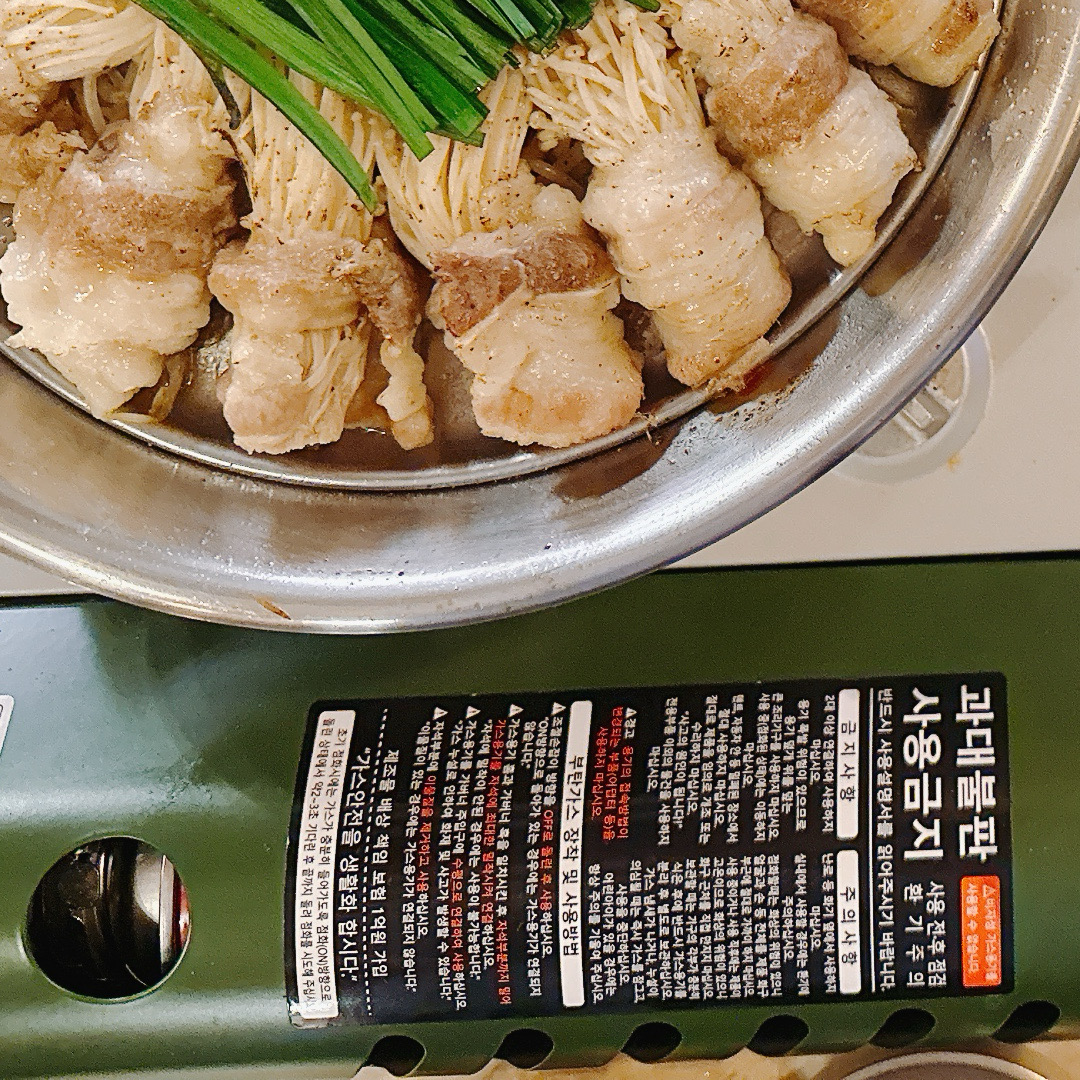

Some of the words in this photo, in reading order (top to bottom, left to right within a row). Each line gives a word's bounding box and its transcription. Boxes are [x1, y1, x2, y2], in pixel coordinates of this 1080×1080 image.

[664, 697, 678, 735] 전용부품
[705, 695, 717, 725] 절대로
[758, 693, 770, 710] 사용
[798, 700, 810, 719] 용기
[824, 695, 835, 711] 2대
[878, 688, 893, 734] 반드시
[321, 719, 335, 735] 돌린
[610, 707, 623, 747] 변경되는
[624, 718, 636, 738] 경고
[718, 709, 730, 730] 절대
[731, 717, 743, 744] 자동차
[770, 705, 782, 751] 조리기구를
[784, 715, 796, 735] 용기
[797, 723, 809, 744] 폭발
[824, 715, 835, 735] 이상
[335, 729, 348, 745] 초기
[427, 721, 444, 771] 자석부분에
[461, 720, 477, 770] 가스용기를
[489, 720, 506, 770] 가스용기를
[504, 719, 520, 759] 가스용기
[547, 717, 563, 769] 조절손잡이
[595, 727, 608, 768] 사용하지
[662, 738, 674, 767] 이외의
[690, 722, 702, 763] 수리하지
[703, 728, 715, 758] 제품을
[730, 746, 741, 756] 안
[313, 740, 329, 777] 상태에서
[446, 749, 459, 781] 누설로
[621, 746, 633, 777] 용기의
[646, 747, 660, 792] 마십시오.
[675, 751, 687, 782] 원인이
[716, 733, 728, 775] 사용하지
[729, 759, 741, 768] 등
[742, 743, 754, 788] 마십시오.
[796, 748, 808, 780] 위험이
[823, 740, 834, 783] 연결하여
[326, 750, 344, 797] 점화시에는
[379, 750, 399, 792] 제조물
[410, 770, 424, 790] 있는
[660, 770, 672, 801] 물건을
[701, 762, 713, 793] 임의로
[768, 754, 780, 794] 사용하지
[782, 765, 794, 786] 위를
[903, 687, 943, 860] 사용금지
[956, 685, 998, 862] 과대불판
[420, 776, 436, 817] 이물질을
[441, 785, 455, 818] 인하여
[457, 774, 471, 805] 가버너
[486, 776, 500, 808] 자석에
[529, 783, 543, 818] 돌아가
[543, 773, 557, 807] 방향을
[566, 756, 584, 820] 부탄가스
[591, 773, 604, 820] 마십시오.
[687, 768, 700, 815] 마십시오.
[714, 780, 726, 828] 마십시오.
[878, 739, 892, 838] 사용설명서를
[322, 801, 336, 831] 가스가
[375, 798, 392, 827] 배상
[405, 794, 421, 838] 경우에는
[471, 795, 484, 817] 안된
[498, 790, 512, 823] 가버너
[617, 783, 631, 838] 접속방법이
[700, 797, 712, 819] 개조
[755, 801, 766, 841] 이동하지
[796, 785, 807, 831] 있으므로
[822, 786, 834, 832] 사용하지
[304, 824, 317, 852] 기다린
[439, 823, 451, 845] 화재
[454, 810, 467, 853] 주입구에
[483, 813, 497, 846] 최대한
[527, 822, 539, 845] 있는
[542, 810, 554, 841] OFF로
[658, 804, 670, 845] 사용하지
[699, 822, 710, 844] 또는
[727, 803, 739, 843] 장소에서
[302, 855, 314, 865] 후
[319, 835, 331, 865] 충분히
[372, 834, 389, 864] 책임
[419, 823, 432, 866] 제거하고
[438, 850, 450, 861] 및
[469, 822, 482, 867] 경우에는
[563, 828, 579, 861] 장착
[403, 842, 417, 898] 가스용기가
[451, 858, 464, 903] 수평으로
[495, 856, 508, 900] 일치시킨
[526, 848, 539, 894] 경우에는
[541, 873, 552, 885] 후
[562, 870, 578, 884] 및
[588, 864, 601, 887] 항상
[644, 868, 655, 890] 가스
[727, 857, 738, 876] 사용
[794, 853, 806, 895] 실내에서
[822, 853, 834, 876] 난로
[301, 868, 314, 896] 끝까지
[317, 870, 329, 921] 들어가도록
[338, 855, 359, 912] 생활화
[370, 870, 386, 900] 보험
[436, 866, 448, 901] 사고가
[467, 872, 480, 906] 사용이
[658, 888, 669, 899] 후
[713, 857, 724, 909] 고온이므로
[755, 893, 766, 904] 손
[822, 880, 834, 892] 등
[878, 844, 893, 926] 읽어주시기
[926, 881, 945, 915] 사용
[300, 900, 312, 918] 돌려
[497, 905, 508, 917] 후
[588, 891, 601, 924] 주의를
[602, 873, 614, 929] 어린아이가
[616, 884, 627, 918] 사용을
[644, 895, 655, 928] 냄새가
[740, 888, 752, 915] 절대로
[755, 908, 766, 920] 등
[795, 898, 807, 928] 사용할
[823, 896, 834, 917] 화기
[966, 883, 978, 917] 사용할
[300, 921, 312, 948] 점화를
[370, 907, 386, 944] 1억원
[402, 902, 415, 944] 연결되지
[436, 905, 449, 938] 발생할
[451, 907, 463, 949] 연결하여
[526, 899, 538, 954] 가스용기가
[562, 892, 579, 956] 사용방법
[658, 904, 669, 937] 별도로
[672, 915, 684, 948] 반드시
[714, 912, 725, 941] 화상의
[728, 919, 739, 937] 사용
[768, 909, 780, 939] 화상의
[968, 920, 978, 931] 수
[437, 942, 448, 953] 수
[496, 920, 510, 982] 자석부분까지
[603, 933, 614, 954] 있을
[631, 944, 643, 973] 가스를
[715, 944, 726, 971] 위험이
[769, 942, 781, 969] 위험이
[796, 931, 808, 968] 경우에는
[302, 952, 314, 977] 시도해
[372, 950, 388, 977] 가입
[529, 958, 541, 996] 연결되지
[605, 958, 616, 996] 경우에는
[674, 951, 686, 998] 가스용기를
[824, 956, 836, 993] 사용하지
[879, 932, 896, 992] 바랍니다.
[927, 959, 946, 987] 점검
